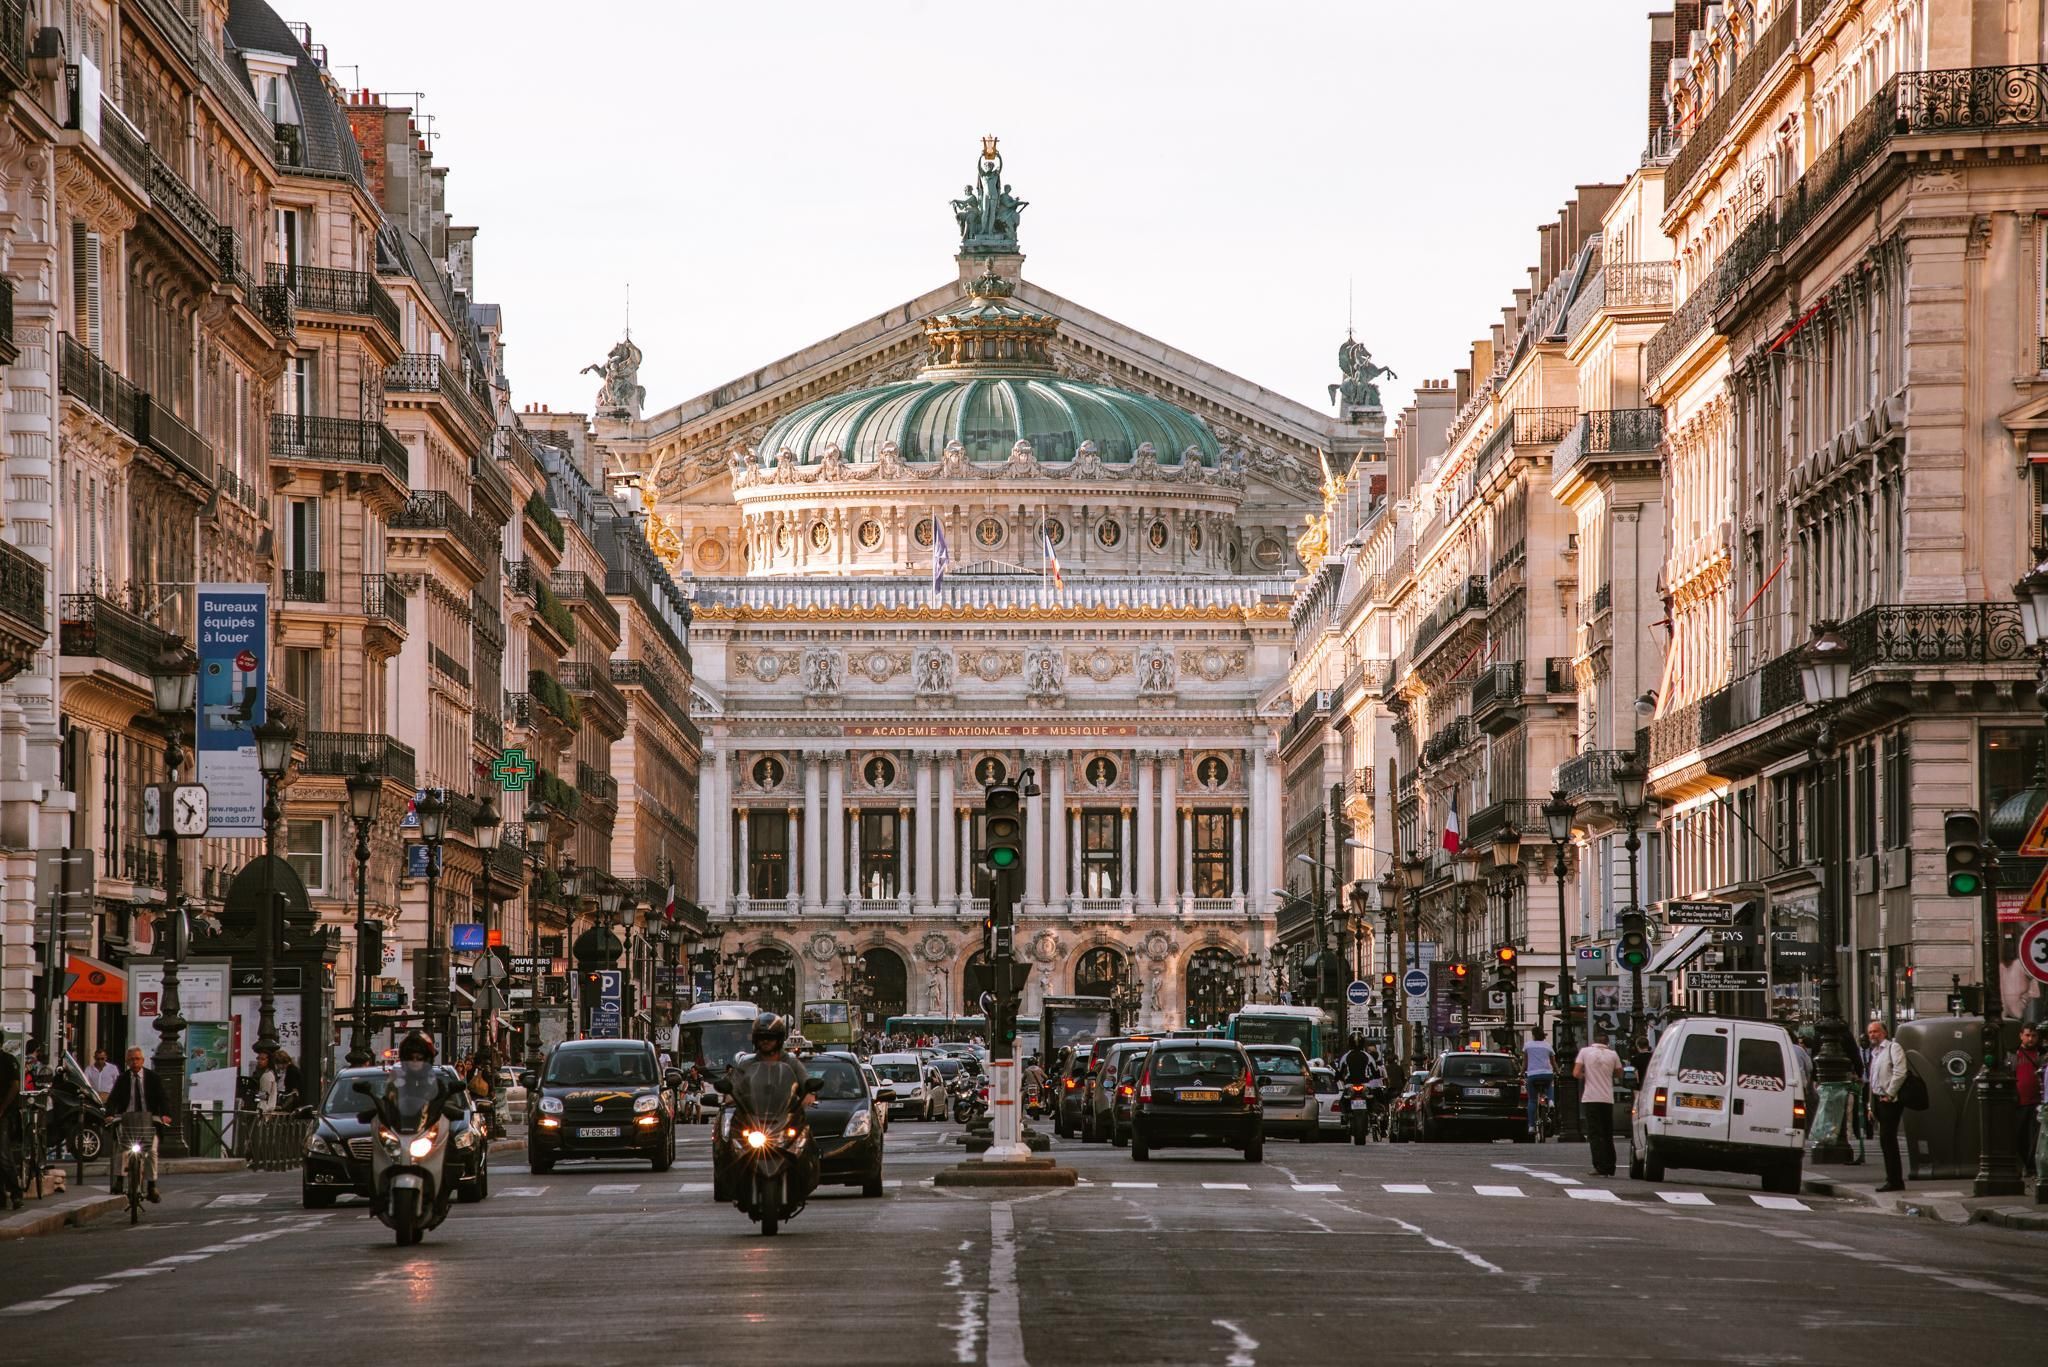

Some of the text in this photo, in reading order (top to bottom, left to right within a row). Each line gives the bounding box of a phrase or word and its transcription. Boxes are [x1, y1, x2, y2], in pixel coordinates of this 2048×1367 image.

[204, 601, 258, 612] Bureaux
[204, 616, 255, 629] équipés
[204, 631, 249, 643] à louer
[872, 727, 1109, 736] ACADEMIE NATIONALE DE MUSIQUE
[1581, 950, 1601, 958] CIC
[601, 976, 614, 992] P
[1687, 1072, 1717, 1082] SERVICE
[1746, 1078, 1776, 1088] SERVICE
